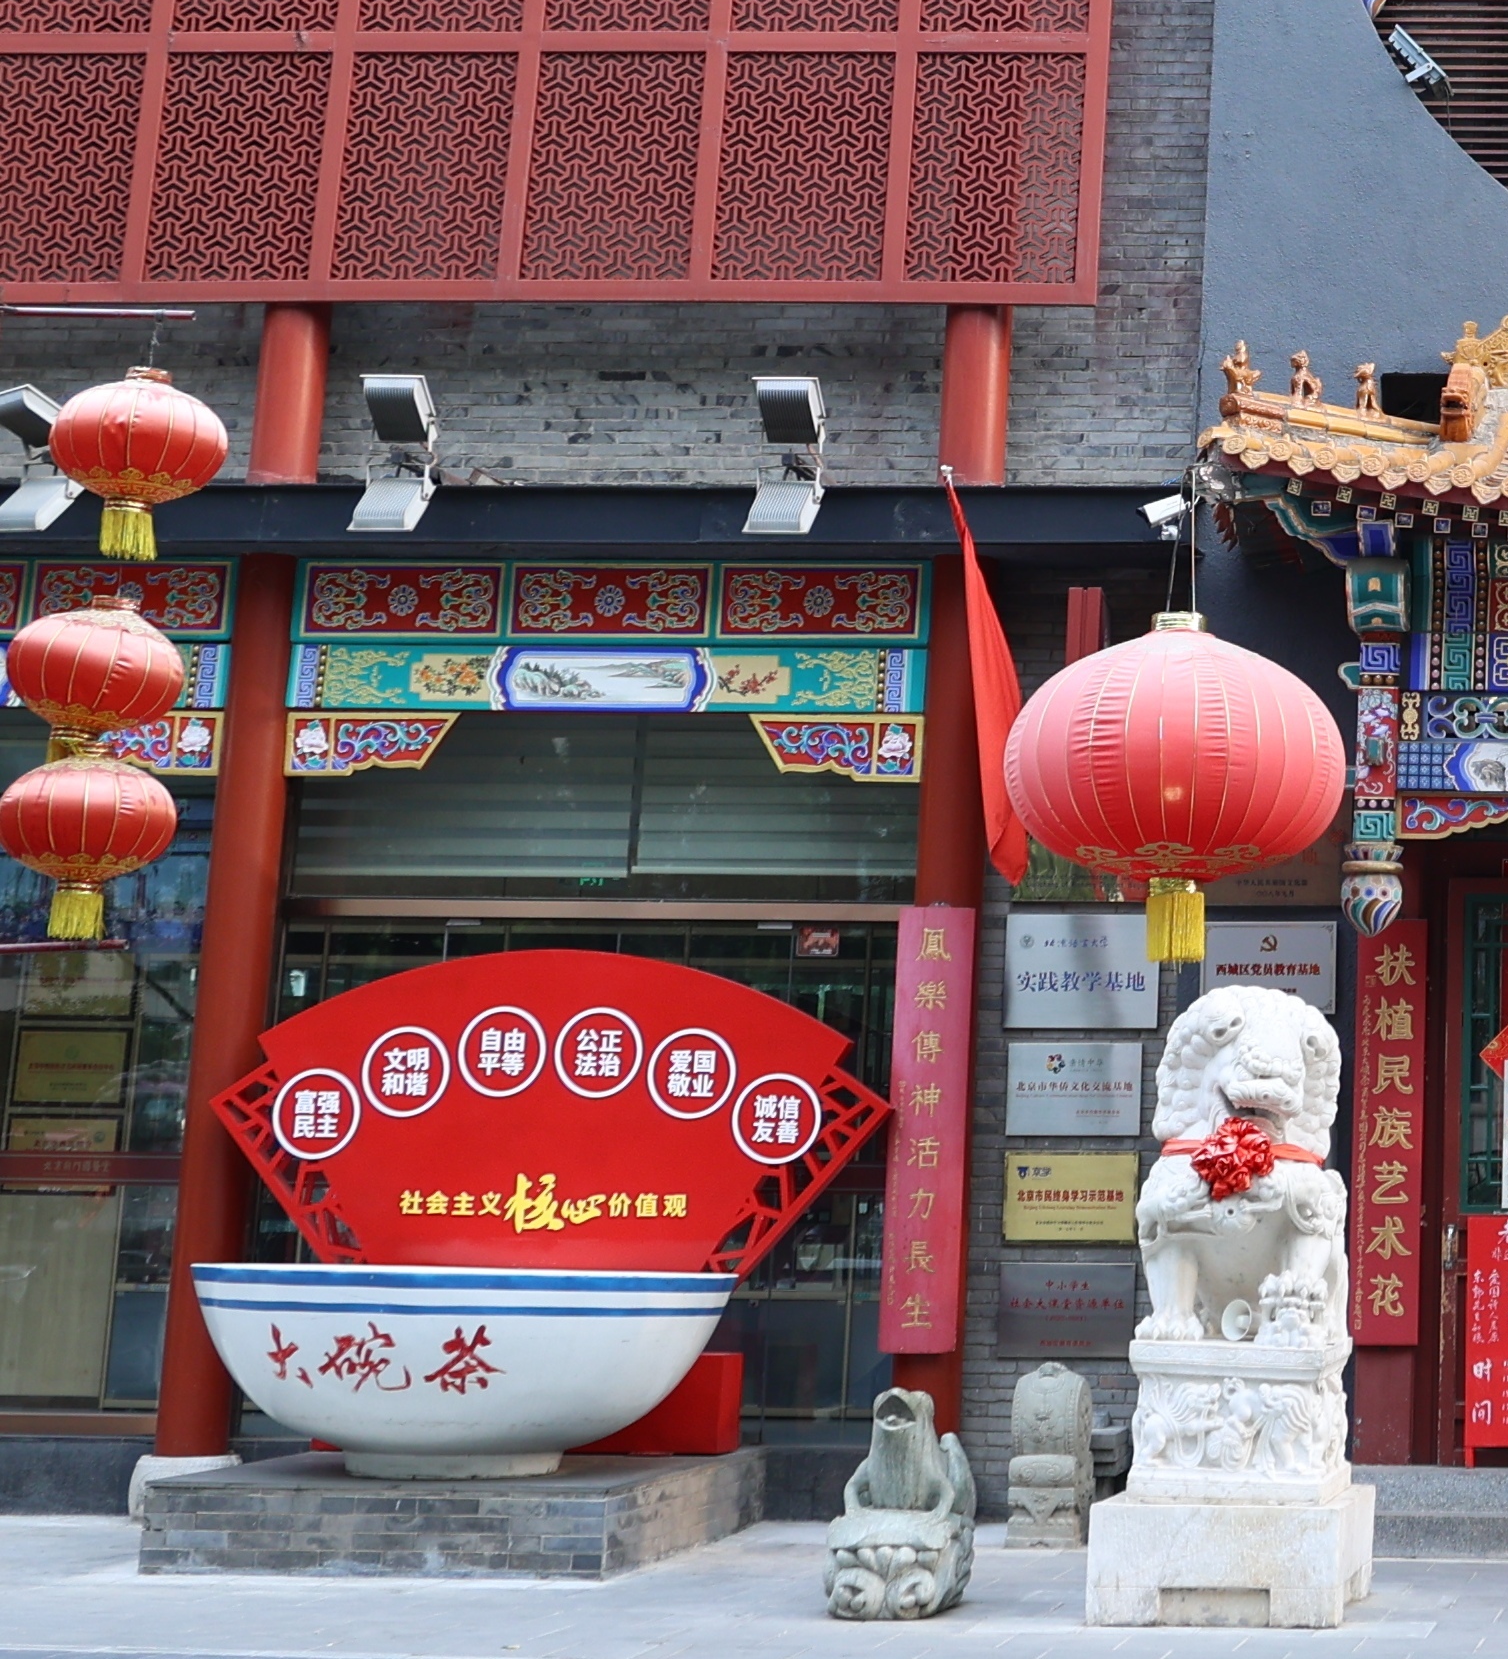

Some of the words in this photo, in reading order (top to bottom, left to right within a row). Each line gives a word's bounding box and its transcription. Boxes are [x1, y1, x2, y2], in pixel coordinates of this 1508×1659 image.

[1017, 970, 1146, 992] 实践教学基地
[1215, 963, 1321, 976] 西城区党员教育基地
[480, 1028, 527, 1052] 自由
[575, 1029, 623, 1054] 公正
[382, 1046, 430, 1073] 文明
[477, 1051, 526, 1077] 平等
[574, 1053, 621, 1079] 法治
[669, 1049, 717, 1075] 爱国
[381, 1071, 429, 1097] 和谐
[667, 1072, 715, 1099] 敬业
[294, 1089, 341, 1116] 富强
[753, 1094, 801, 1120] 诚信
[293, 1114, 339, 1140] 民主
[752, 1119, 800, 1144] 友善
[1366, 942, 1417, 1317] 扶植民族艺术花
[399, 1173, 688, 1233] 社会主义核心价值观
[1017, 1189, 1124, 1203] 北京市民终身学习示范基地
[268, 1320, 507, 1394] 大碗茶
[1472, 1358, 1493, 1425] 时间
